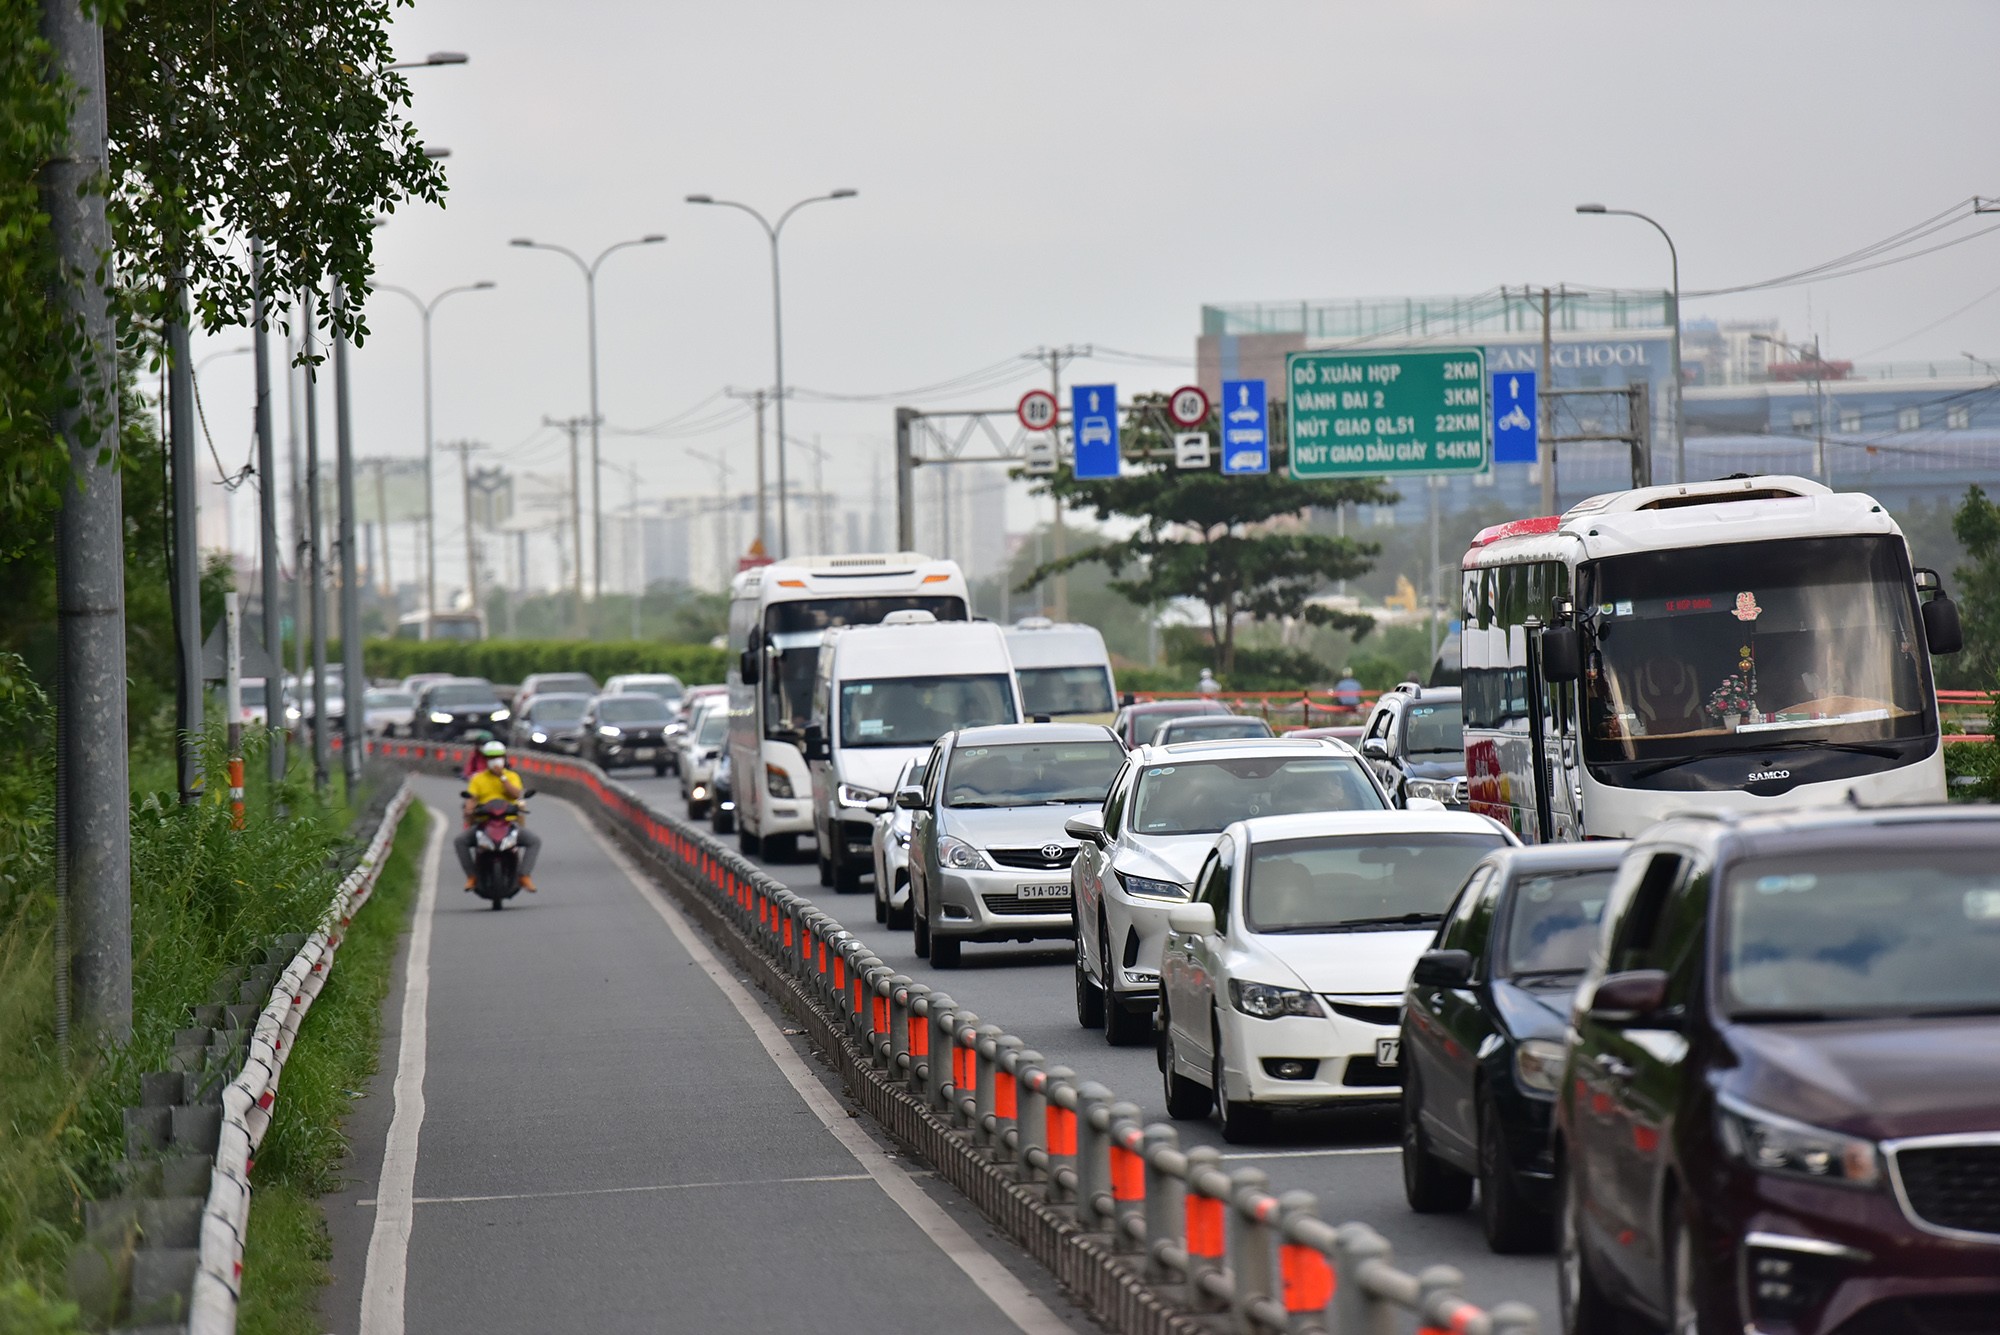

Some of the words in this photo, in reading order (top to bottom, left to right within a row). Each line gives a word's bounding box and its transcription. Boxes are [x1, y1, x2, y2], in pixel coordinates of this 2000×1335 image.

[1320, 361, 1363, 384] XUÂN
[1443, 361, 1479, 381] 2KM
[1373, 389, 1385, 409] 2
[1443, 387, 1480, 407] 3KM
[1296, 415, 1328, 437] NÚT
[1333, 417, 1371, 435] GIAO
[1435, 414, 1480, 433] 22KM
[1296, 441, 1328, 464] NÚT
[1330, 443, 1364, 462] GIAO
[1435, 440, 1481, 460] 54KM
[1747, 769, 1790, 782] SAMCO
